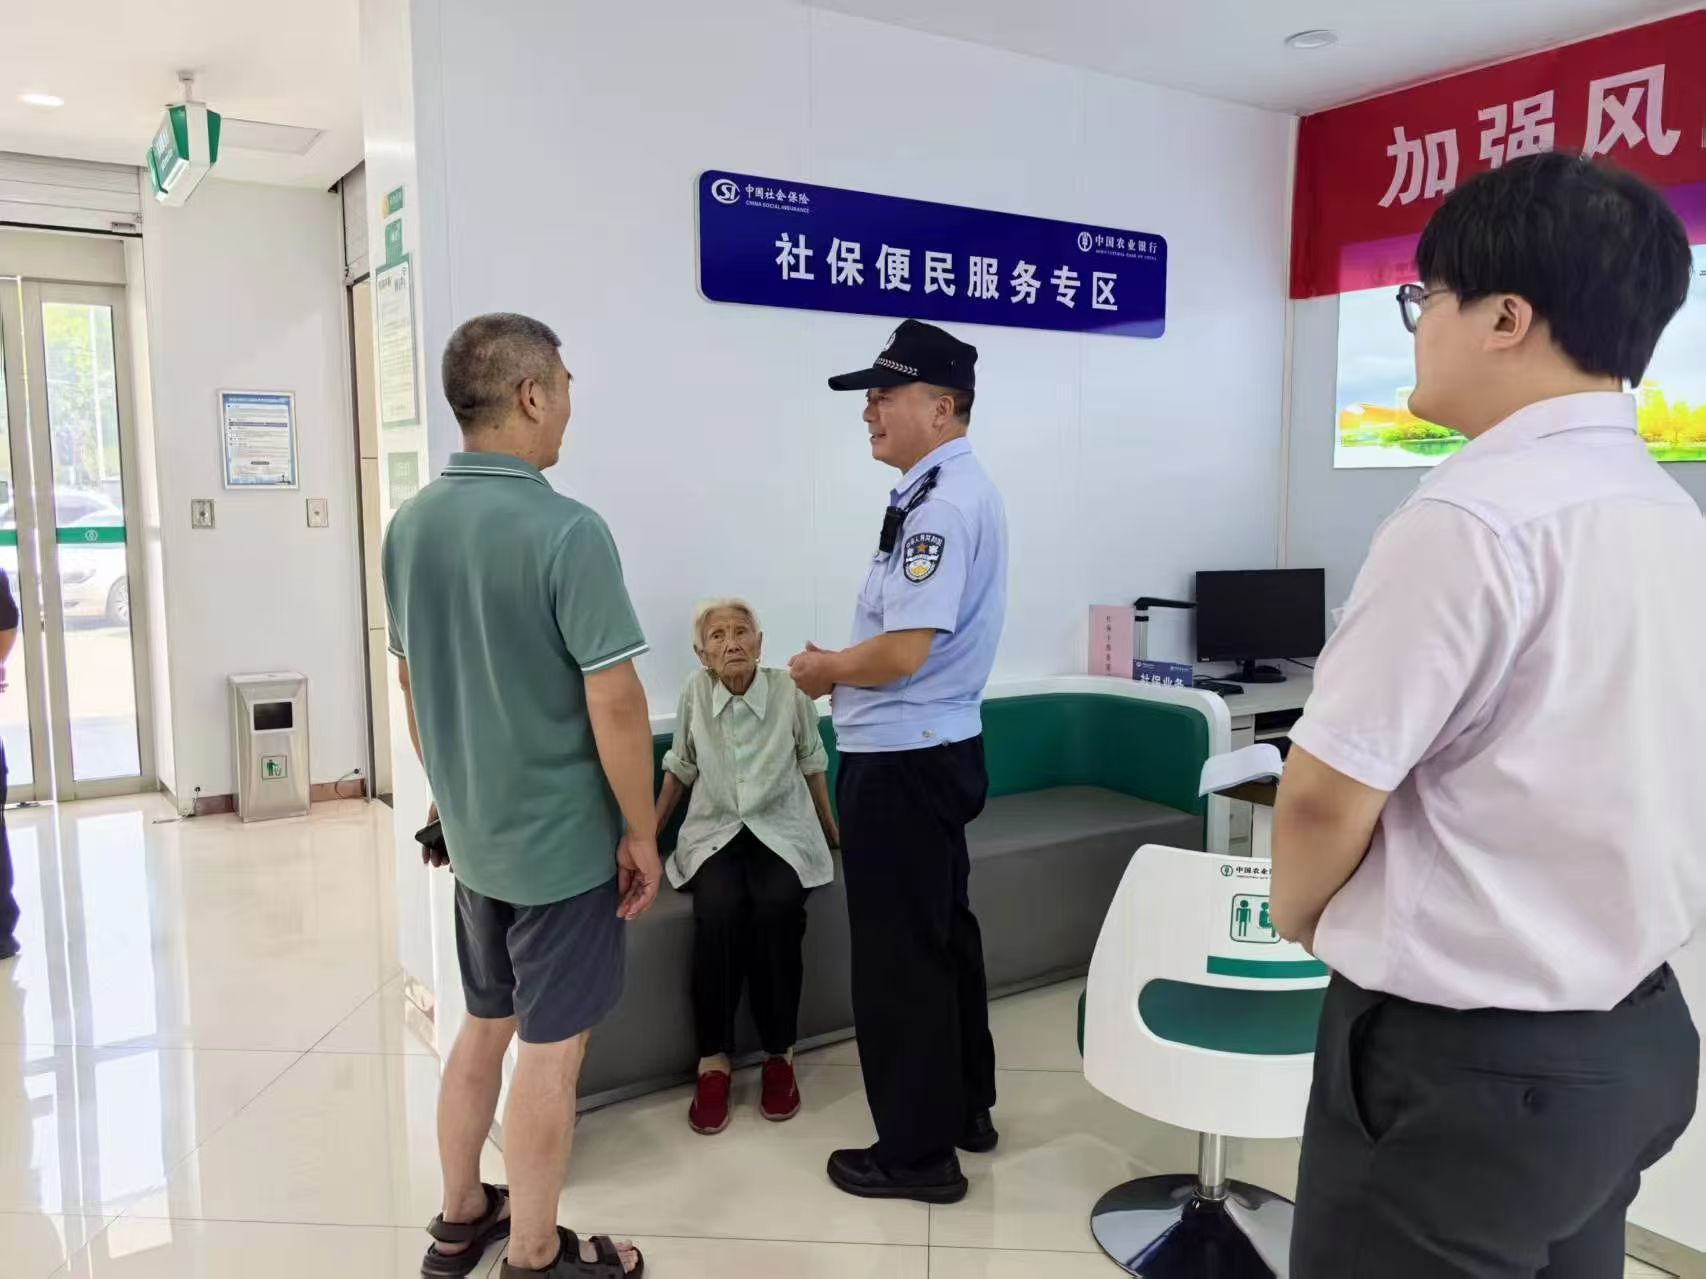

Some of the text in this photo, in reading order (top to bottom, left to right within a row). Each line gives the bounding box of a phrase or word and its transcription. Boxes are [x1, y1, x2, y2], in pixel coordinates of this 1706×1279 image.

[1378, 64, 1706, 207] 加强风
[745, 184, 810, 204] 中国社会保险
[1095, 234, 1158, 254] 中国农业银行
[775, 232, 1118, 311] 社保便民服务专区
